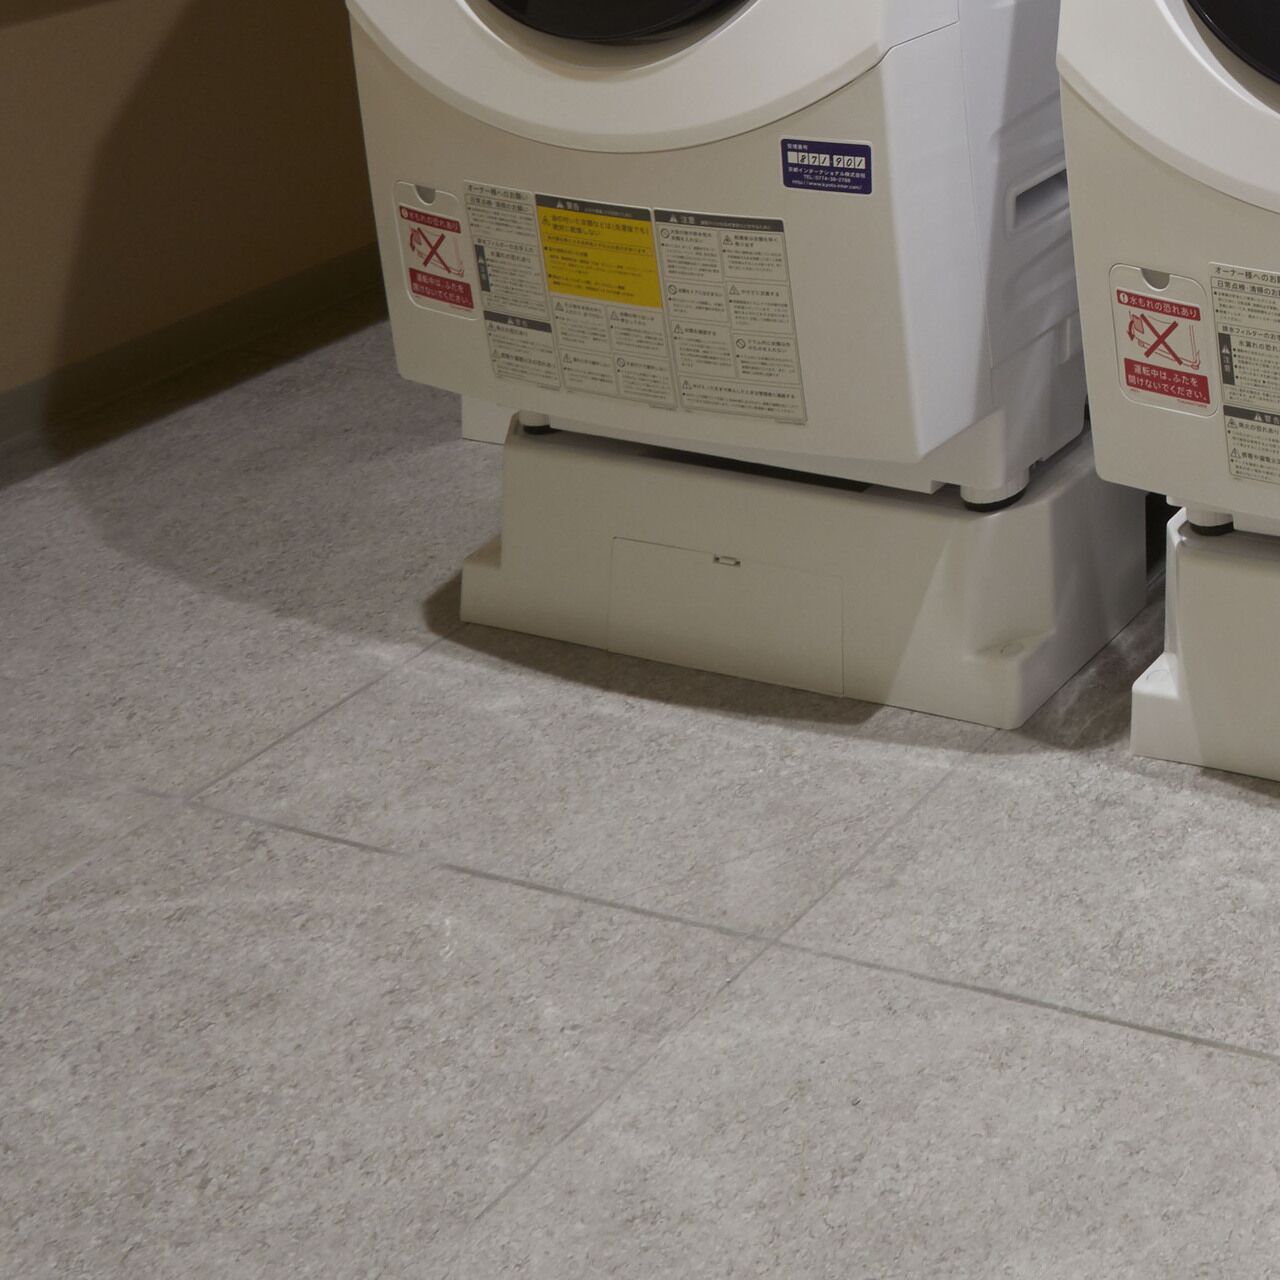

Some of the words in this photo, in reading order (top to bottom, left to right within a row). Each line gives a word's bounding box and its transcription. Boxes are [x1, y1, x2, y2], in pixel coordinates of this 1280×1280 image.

[1130, 296, 1197, 317] 水もれの恐れあり
[1134, 365, 1198, 386] 運転中は、ふたを
[1128, 375, 1207, 400] 開けないでください。
